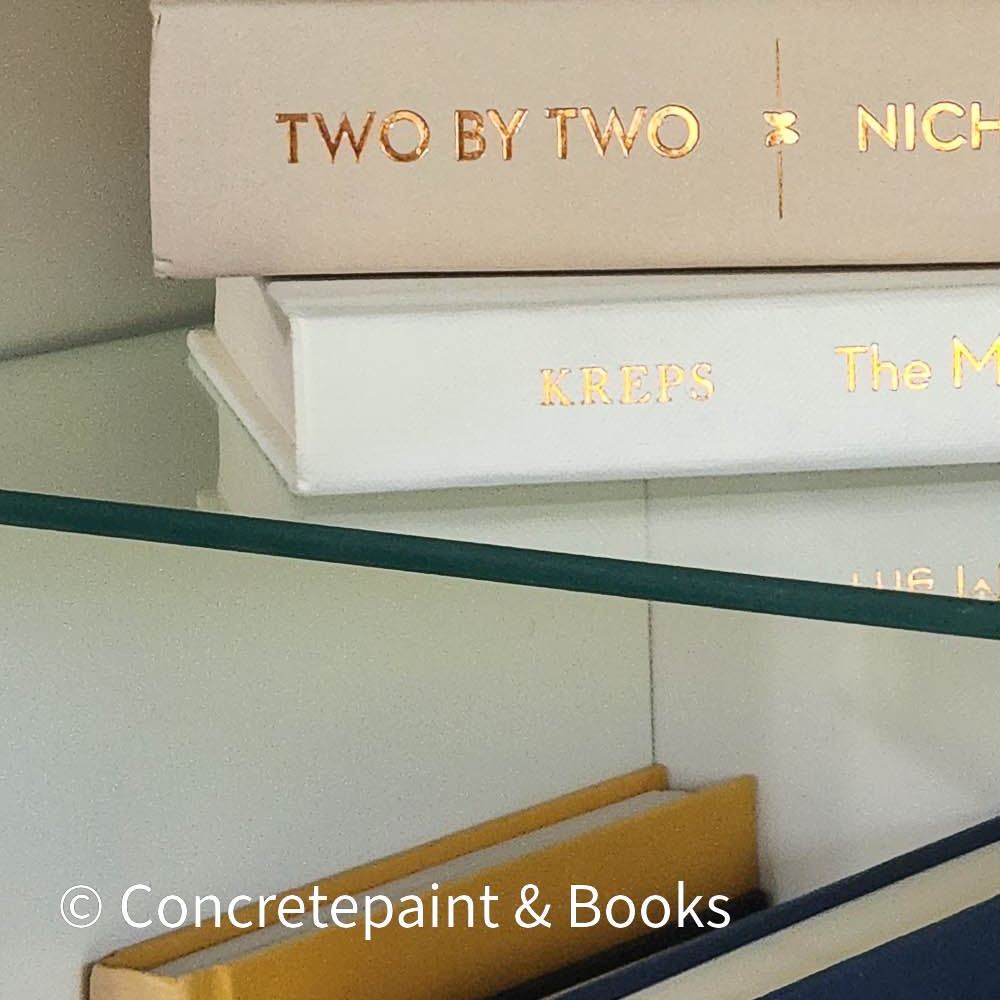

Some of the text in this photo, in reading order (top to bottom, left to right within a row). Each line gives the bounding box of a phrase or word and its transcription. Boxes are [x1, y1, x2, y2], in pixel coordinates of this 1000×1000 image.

[275, 103, 701, 165] TWO BY TWO
[539, 361, 717, 407] KREPS
[835, 343, 932, 393] The
